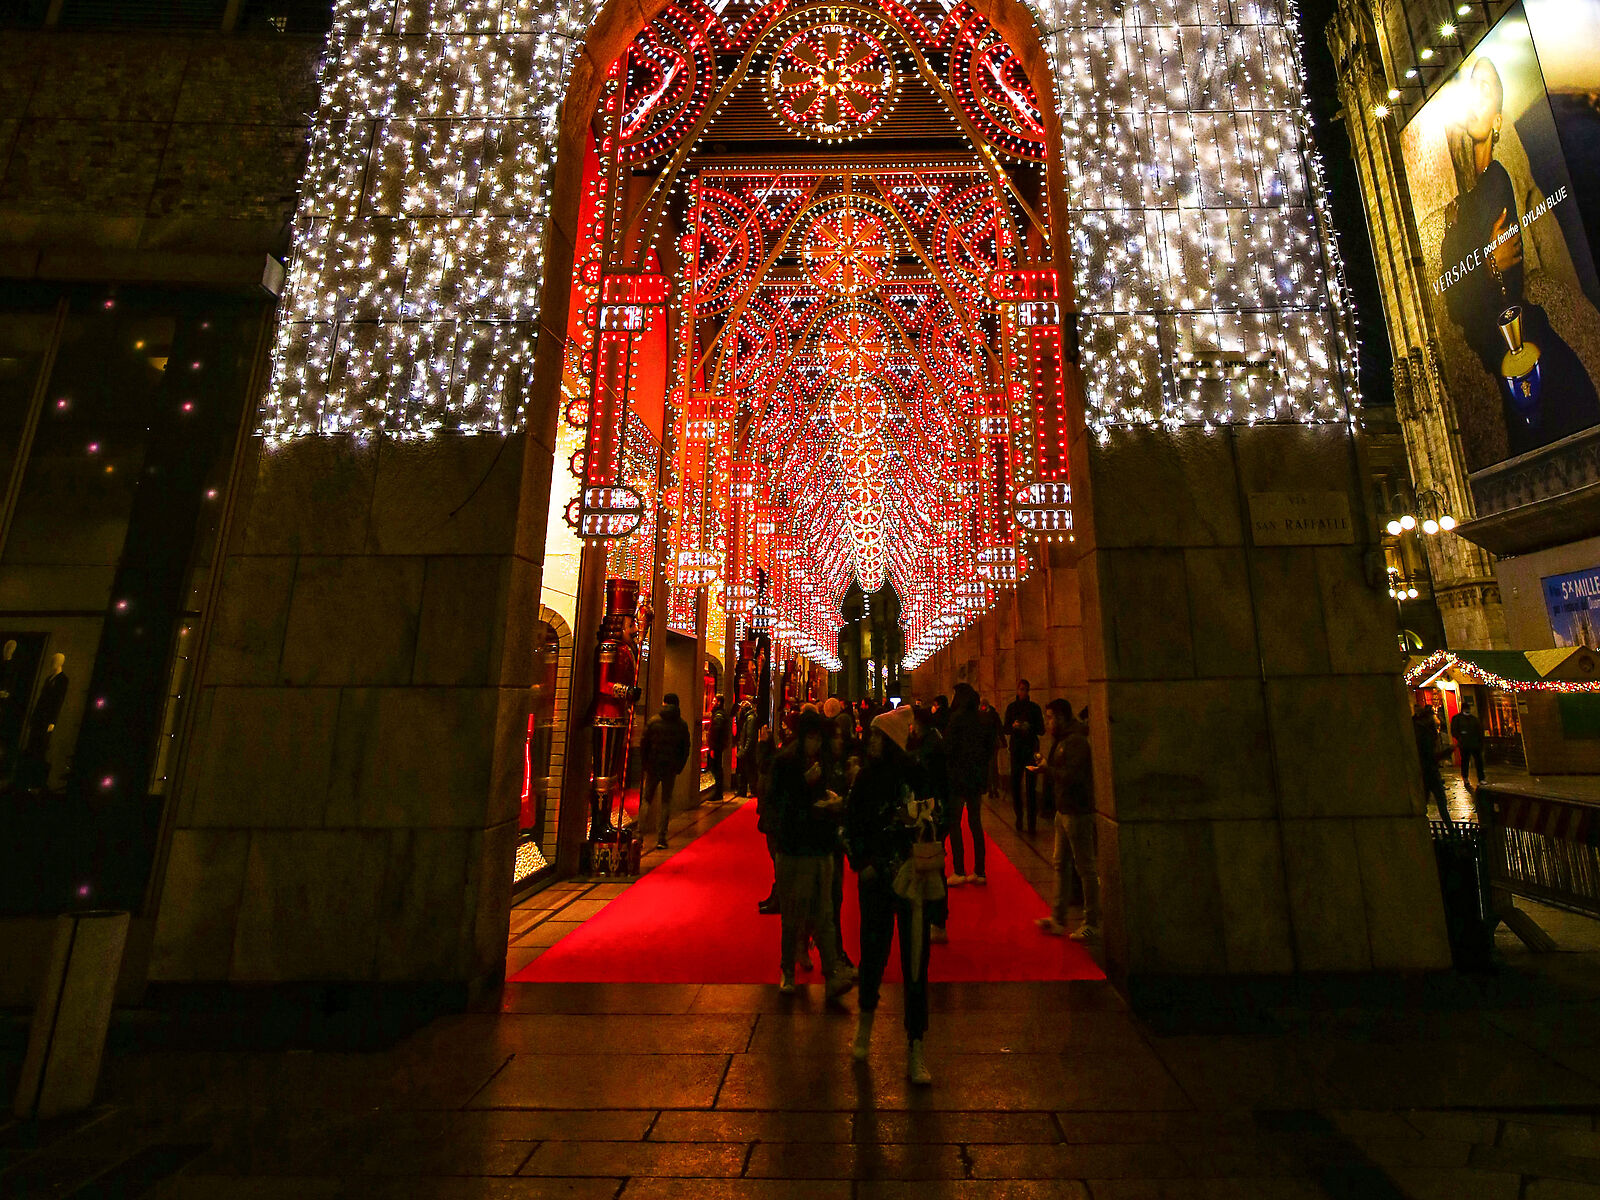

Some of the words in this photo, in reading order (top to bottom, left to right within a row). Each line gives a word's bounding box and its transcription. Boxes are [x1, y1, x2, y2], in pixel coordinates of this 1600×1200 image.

[1432, 248, 1482, 296] VERSACE
[1483, 241, 1498, 258] pour
[1496, 223, 1520, 247] femme
[1521, 201, 1547, 228] DYLAN
[1546, 185, 1568, 210] BLUE
